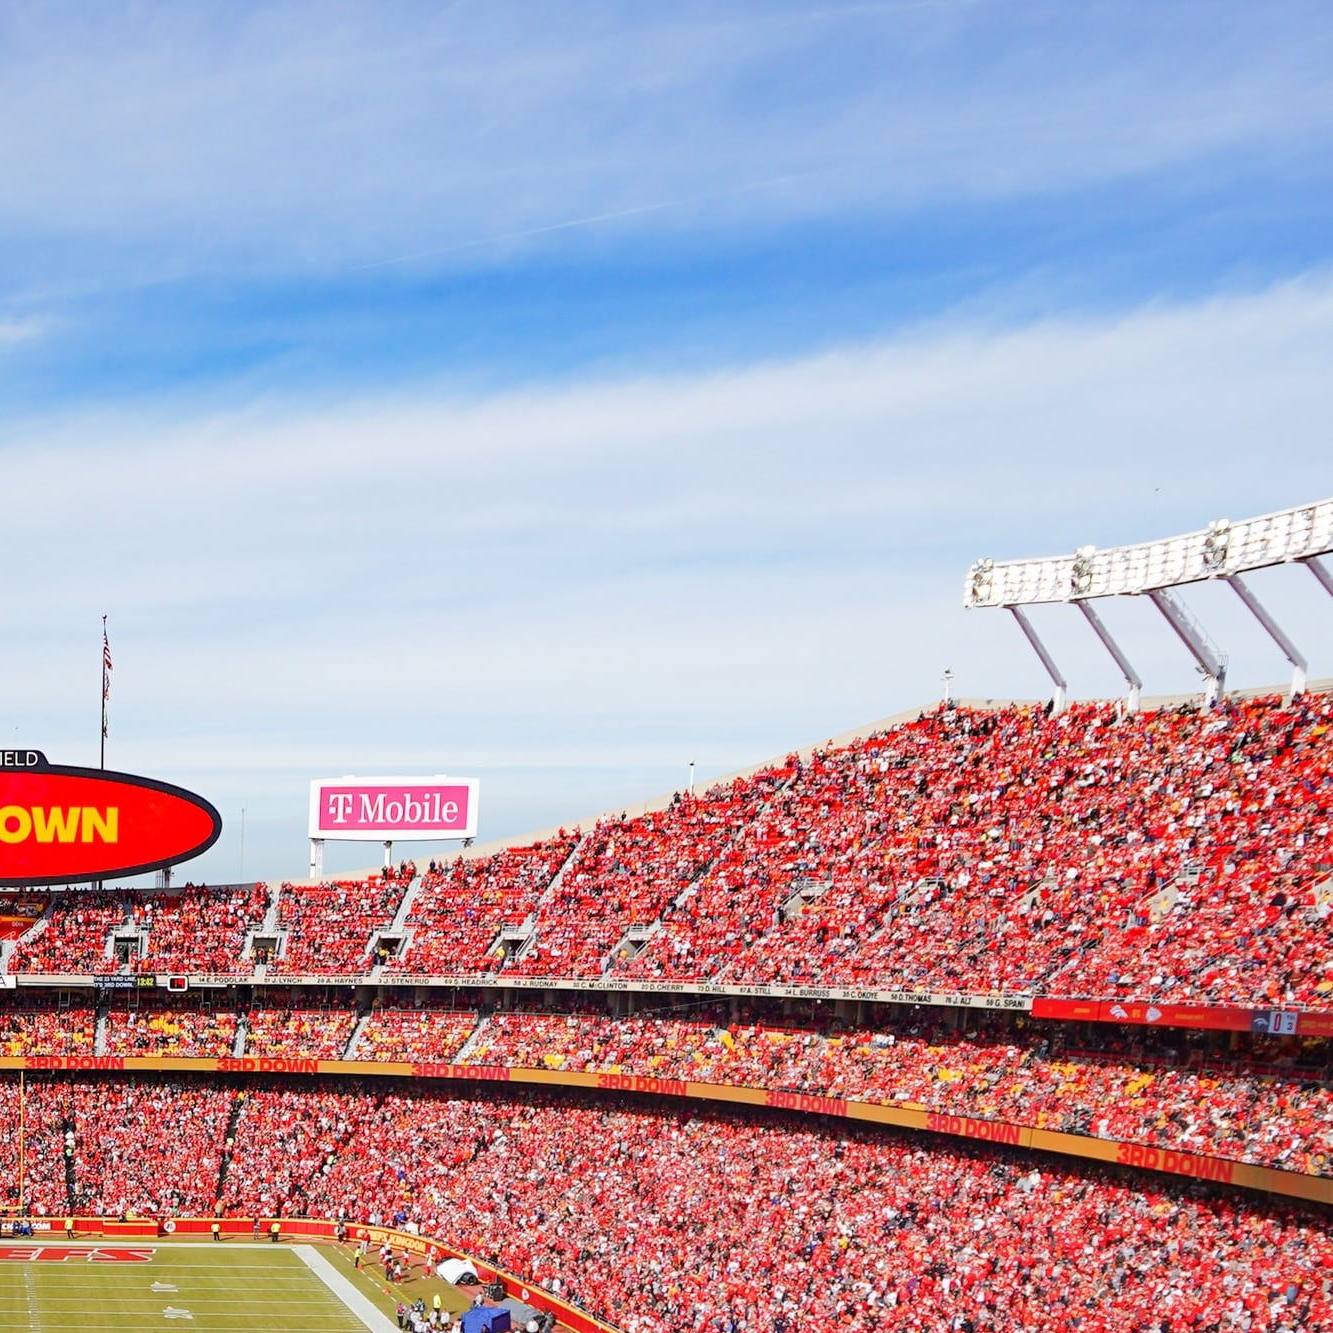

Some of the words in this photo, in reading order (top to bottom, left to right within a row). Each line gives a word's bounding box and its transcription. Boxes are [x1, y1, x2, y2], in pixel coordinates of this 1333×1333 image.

[328, 793, 353, 823] T
[357, 792, 458, 823] Mobile
[1273, 1013, 1282, 1032] 0
[25, 1056, 62, 1070] 3RD
[66, 1056, 124, 1070] DOWN
[216, 1058, 255, 1072] 3RD
[259, 1058, 318, 1073] DOWN
[411, 1063, 449, 1077] 3RD
[452, 1064, 510, 1080] DOWN
[598, 1074, 631, 1089] 3RD
[635, 1076, 688, 1096] DOWN
[765, 1091, 797, 1110] 3RD
[799, 1095, 847, 1116] DOWN
[925, 1112, 962, 1134] 3RD
[965, 1117, 1021, 1145] DOWN
[1116, 1143, 1159, 1169] 3RD
[1163, 1149, 1234, 1184] DOWN
[390, 1234, 425, 1253] KINGDOM
